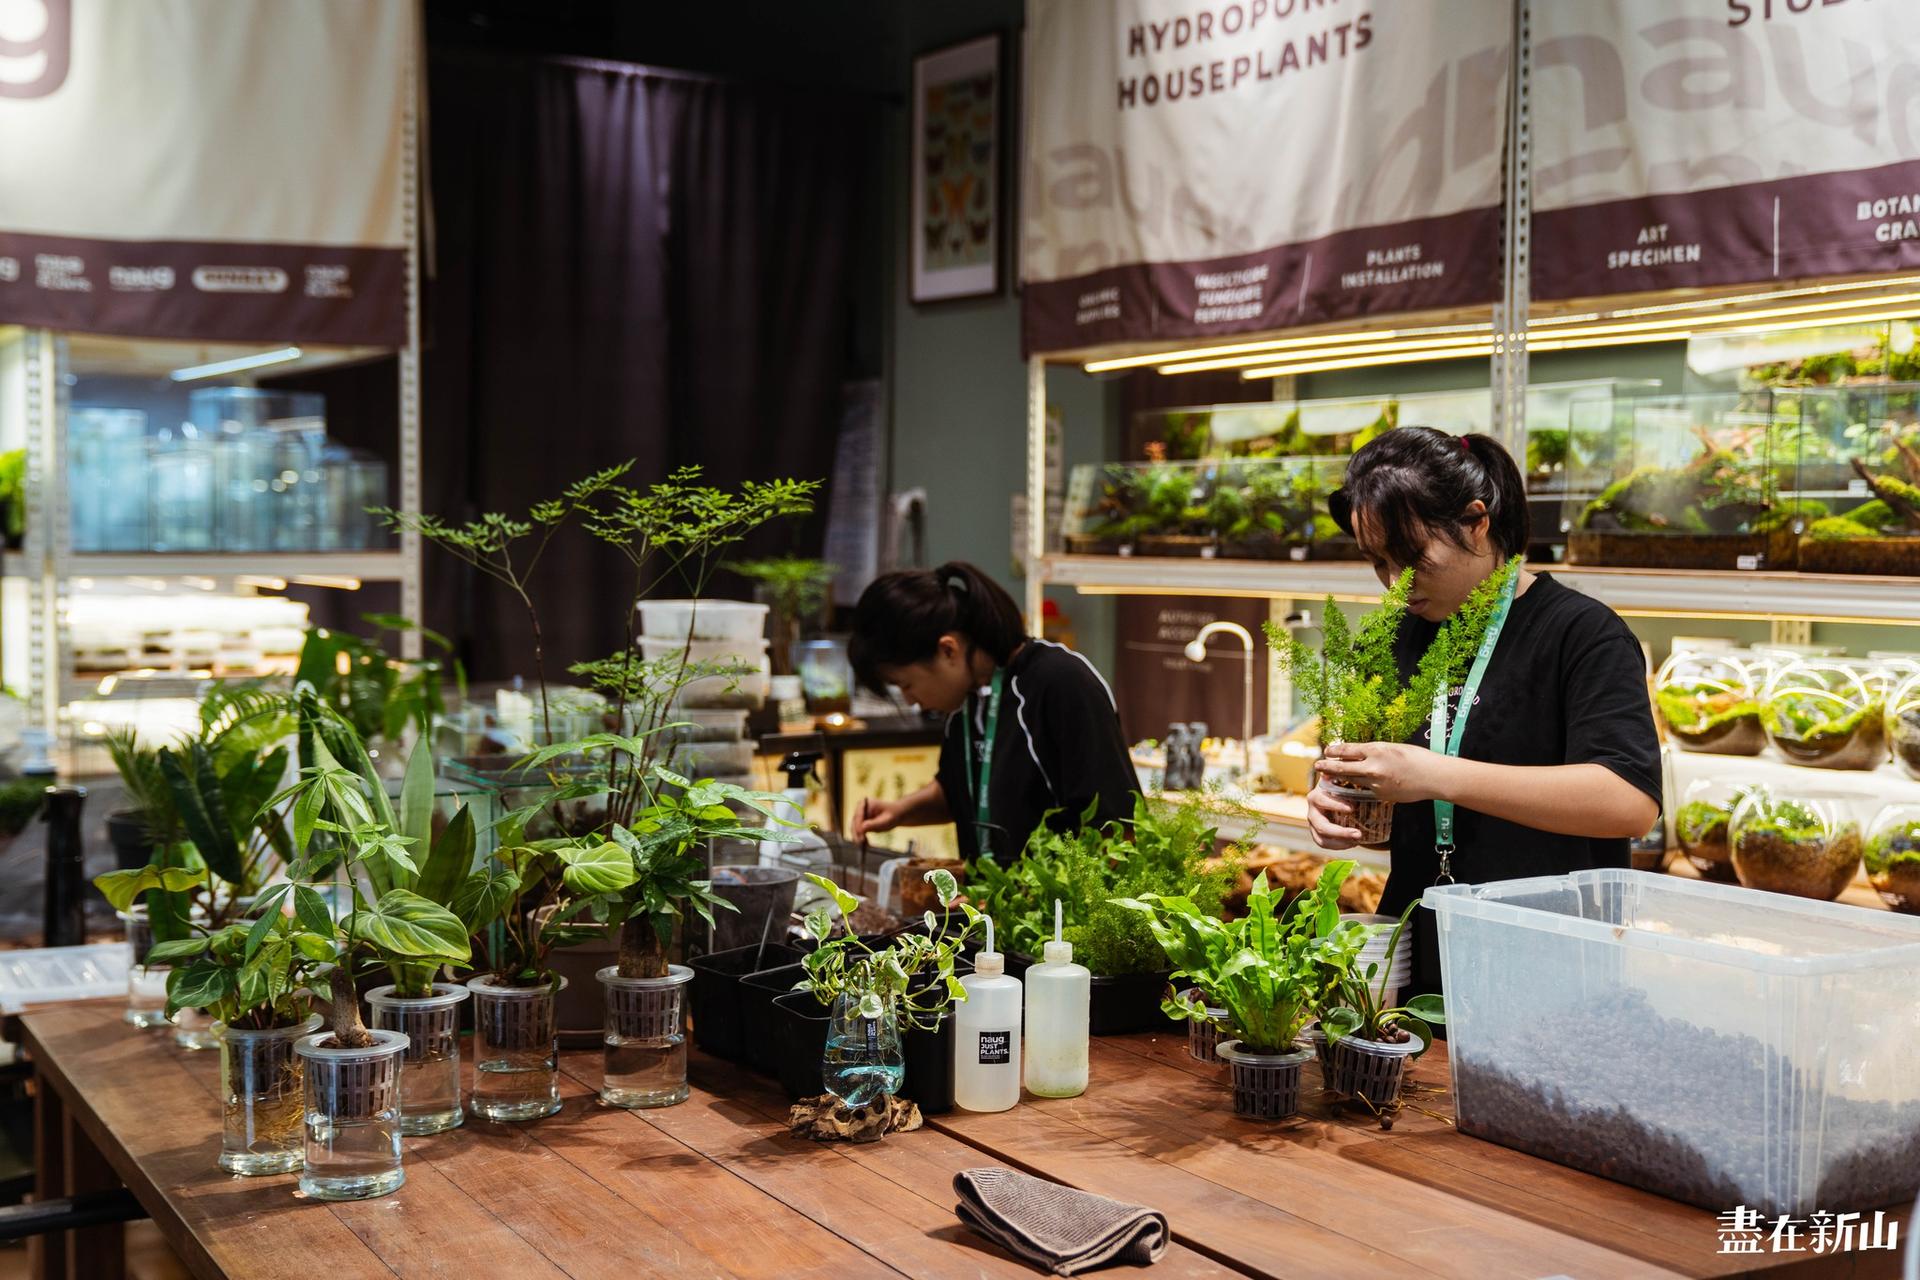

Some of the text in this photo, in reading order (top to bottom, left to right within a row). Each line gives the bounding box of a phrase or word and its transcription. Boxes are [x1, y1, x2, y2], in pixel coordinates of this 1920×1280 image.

[1129, 0, 1340, 58] HYDROPO
[1117, 13, 1373, 111] HOUSEPLANTS
[1637, 223, 1668, 245] ART
[1366, 243, 1421, 267] PLANTS
[1607, 244, 1700, 269] SPECIMEN
[1341, 261, 1444, 290] INSTALLATION
[1458, 686, 1475, 718] naug
[981, 1036, 1005, 1044] naug
